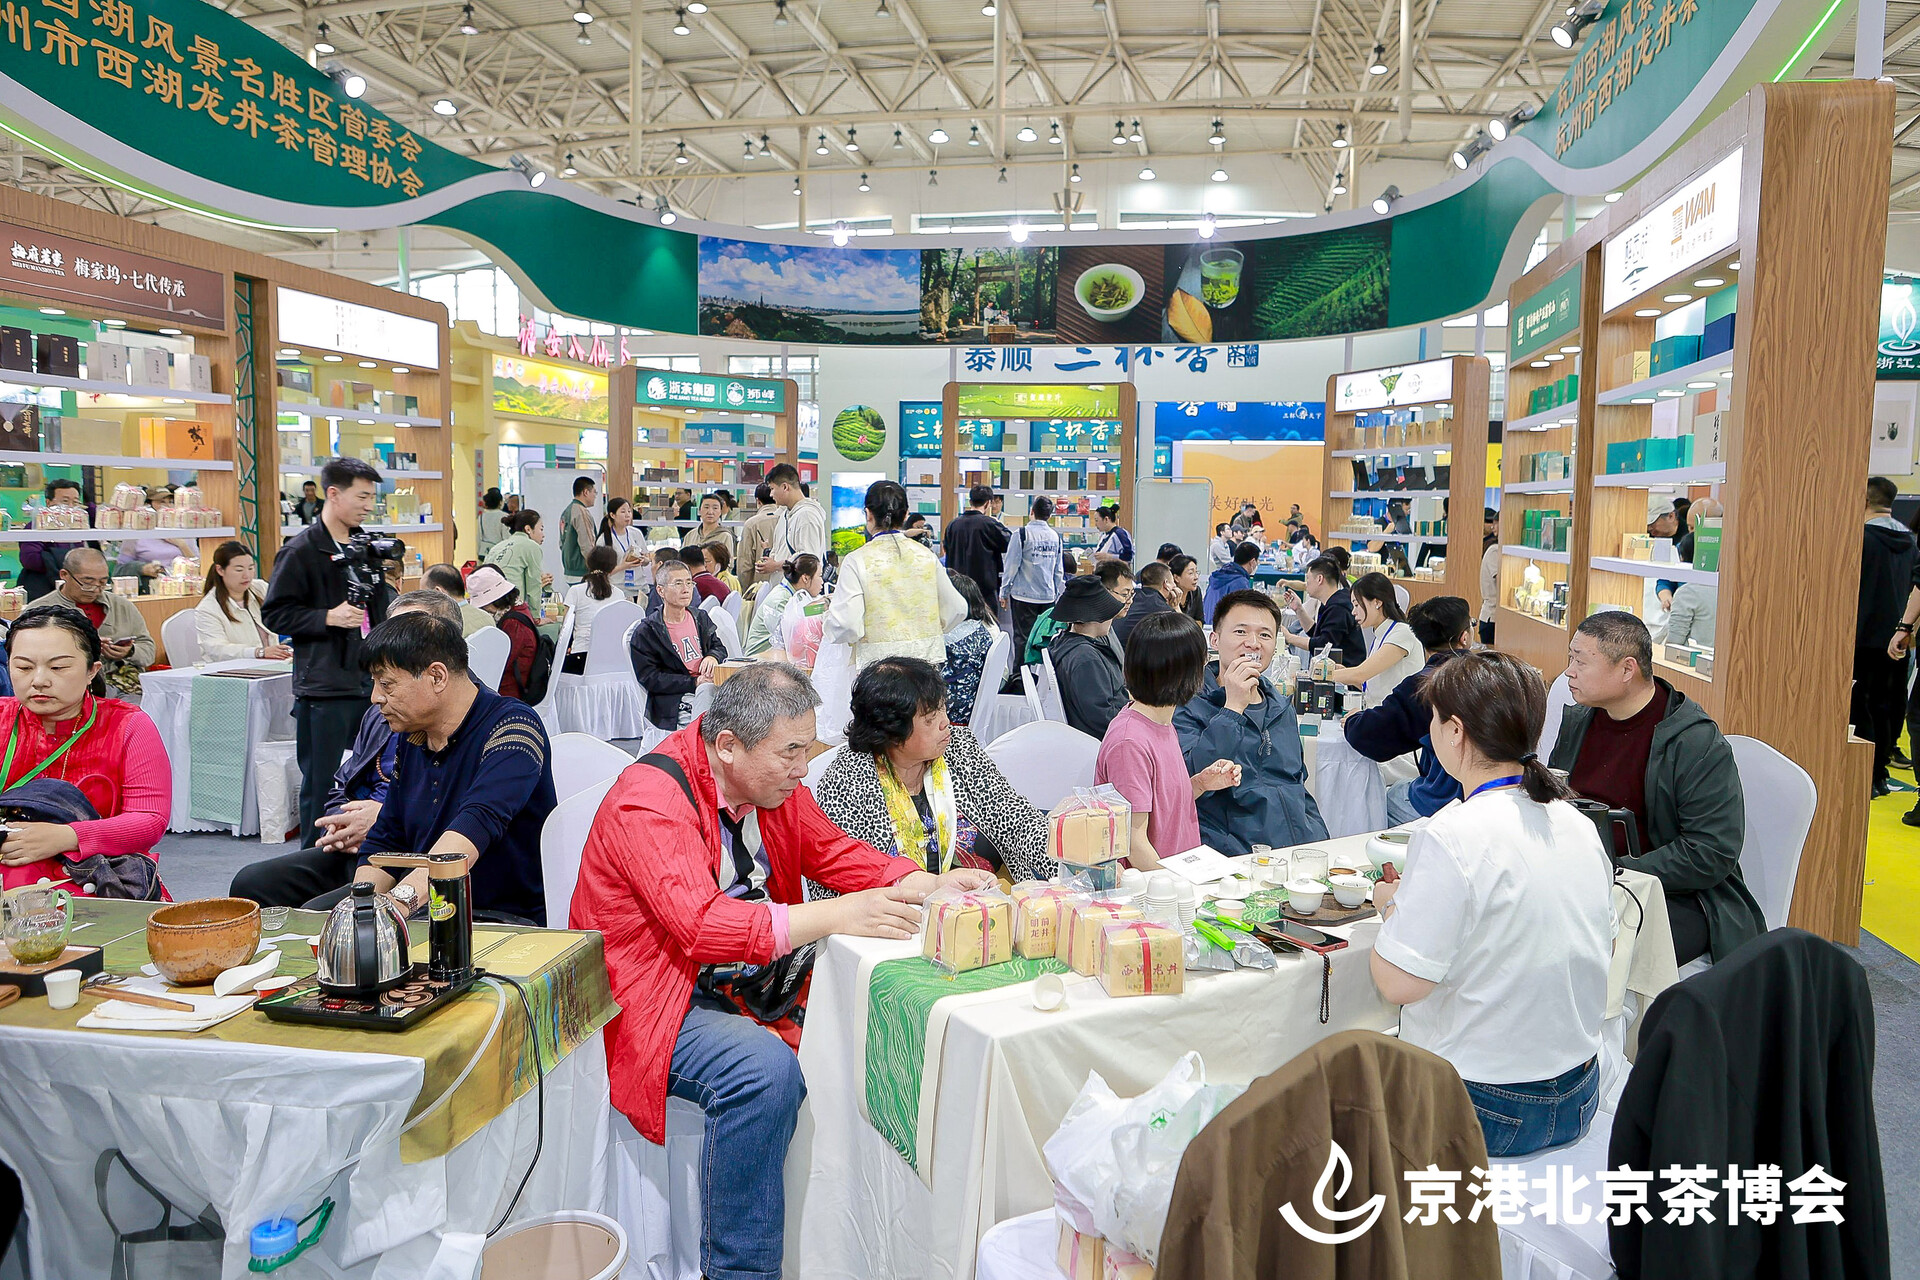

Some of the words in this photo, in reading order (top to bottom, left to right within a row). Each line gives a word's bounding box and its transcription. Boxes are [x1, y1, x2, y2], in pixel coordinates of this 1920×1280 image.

[1685, 182, 1716, 229] WAM
[1876, 357, 1920, 370] 浙江
[669, 381, 715, 397] 浙茶集团
[747, 388, 775, 400] 狮峰
